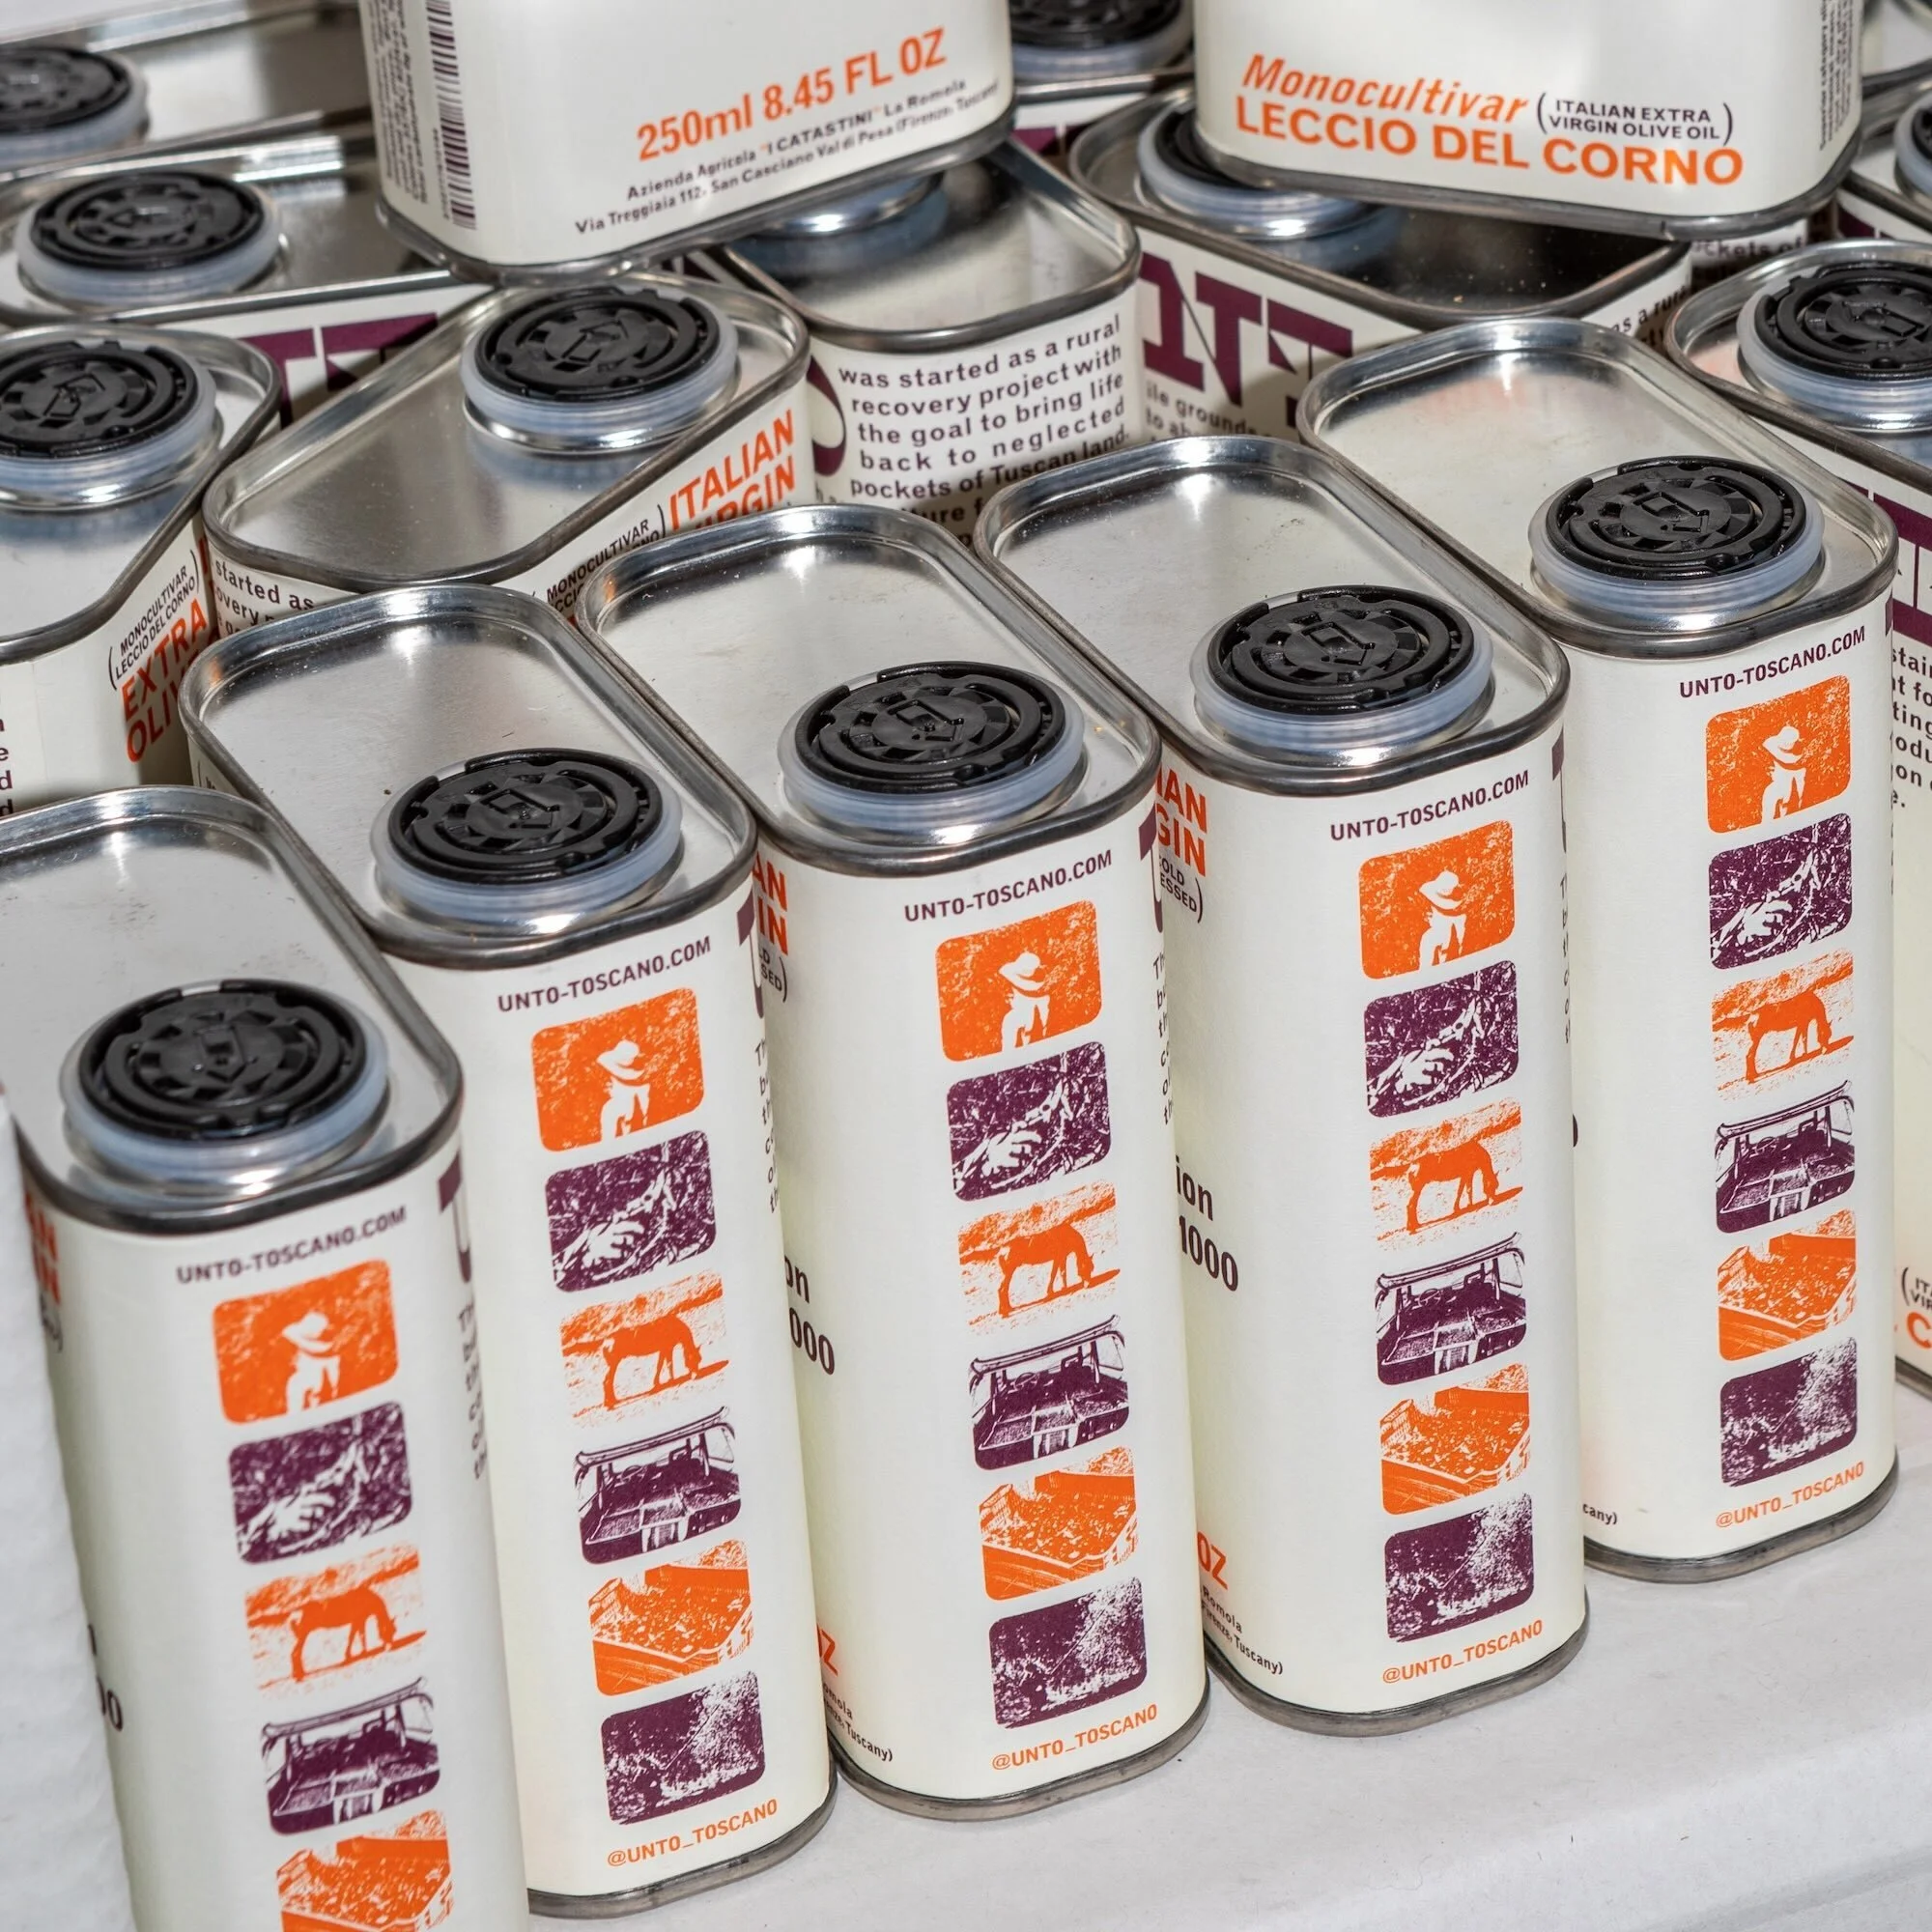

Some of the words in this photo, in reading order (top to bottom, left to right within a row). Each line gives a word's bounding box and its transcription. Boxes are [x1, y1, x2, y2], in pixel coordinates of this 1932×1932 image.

[637, 93, 753, 162] 250ml
[763, 67, 835, 121] 8.45
[844, 50, 894, 95] FL
[898, 25, 948, 76] OZ
[1241, 52, 1529, 123] Monocultivar
[1641, 107, 1711, 123] EXTRA
[627, 169, 694, 201] Azienda
[697, 149, 756, 178] Agricola
[884, 101, 904, 118] La
[1236, 95, 1418, 156] LECCIO
[1432, 125, 1530, 169] DEL
[1543, 137, 1744, 185] CORNO
[1548, 115, 1618, 135] VIRGIN
[1622, 123, 1683, 140] OLIVE
[575, 218, 606, 235] Via
[711, 176, 740, 193] San
[838, 368, 891, 387] was
[899, 355, 1000, 387] started
[1009, 346, 1037, 369] as
[1045, 340, 1059, 357] a
[1065, 313, 1122, 351] rural
[851, 394, 971, 416] recovery
[979, 363, 1069, 408] project
[1074, 343, 1122, 376] with
[858, 421, 901, 444] the
[911, 417, 972, 447] goal
[981, 412, 1008, 433] to
[1016, 390, 1083, 423] bring
[1090, 370, 1124, 400] life
[860, 449, 932, 472] back
[948, 447, 978, 467] to
[993, 396, 1125, 458] neglected
[668, 409, 794, 531] ITALIAN
[851, 479, 952, 499] pockets
[959, 469, 984, 492] of
[991, 442, 1077, 483] Tuscan
[215, 560, 281, 605] started
[289, 594, 314, 611] as
[546, 519, 649, 603] MONOCULTIVAR
[115, 636, 149, 680] LECCIO
[149, 615, 166, 642] DEL
[165, 576, 195, 620] CORNO
[120, 565, 187, 657] MONOCULTIVAR
[122, 598, 208, 723] EXTRA
[1679, 625, 1866, 698] UNTO-TOSCANO.COM
[1330, 770, 1529, 842] UNTO-TOSCANO.COM
[904, 849, 1112, 922] UNTO-TOSCANO.COM
[497, 935, 712, 1012] UNTO-TOSCANO.COM
[176, 1206, 407, 1284] UNTO-TOSCANO.COM
[1179, 1215, 1238, 1292] 1000
[1715, 1460, 1865, 1529] @UNTO_TOSCANO
[1234, 1634, 1284, 1676] Tuscany)
[1381, 1619, 1545, 1685] @UNTO_TOSCANO
[845, 1720, 894, 1763] Tuscany)
[991, 1703, 1158, 1772] @UNTO_TOSCANO
[607, 1798, 779, 1867] @UNTO_TOSCANO
